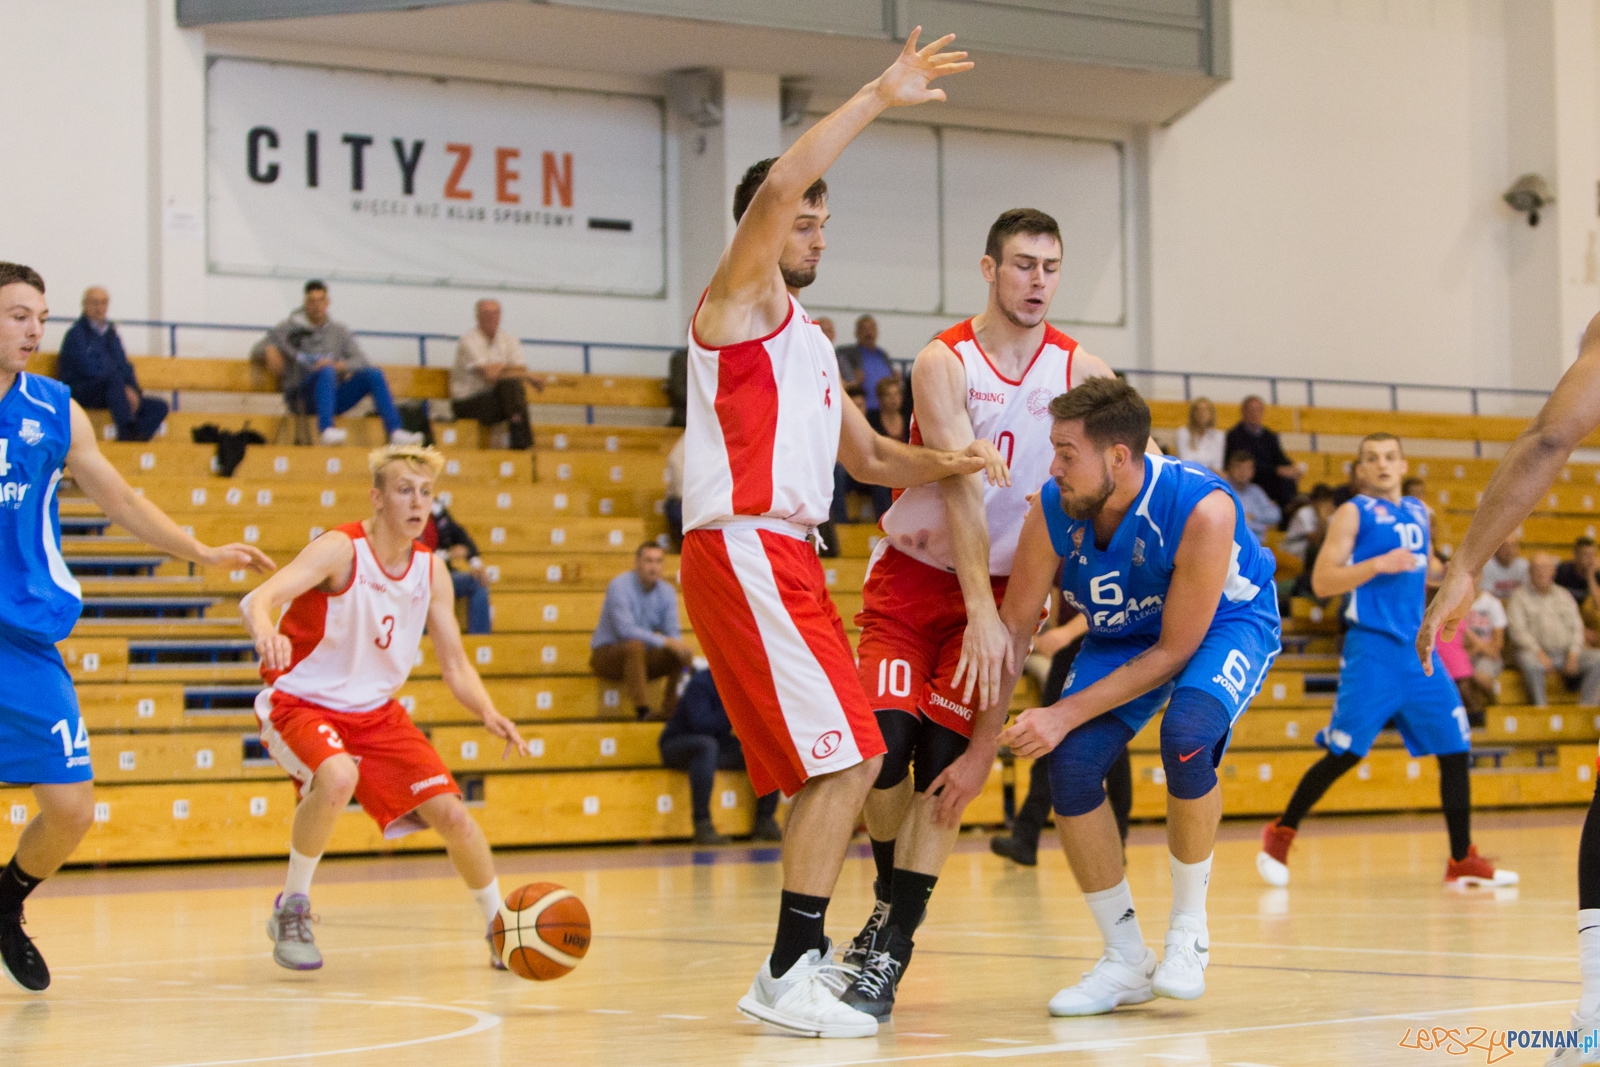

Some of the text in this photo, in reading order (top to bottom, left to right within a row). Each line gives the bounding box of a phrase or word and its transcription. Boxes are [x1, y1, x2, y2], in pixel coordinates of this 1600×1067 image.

[246, 126, 575, 208] CITYZEN
[1393, 522, 1424, 551] 10
[1089, 570, 1124, 606] 6
[374, 615, 395, 650] 3
[877, 658, 912, 698] 10
[1222, 649, 1251, 691] 6
[929, 692, 974, 722] SPALDING
[51, 716, 91, 757] 14
[318, 724, 343, 749] 3
